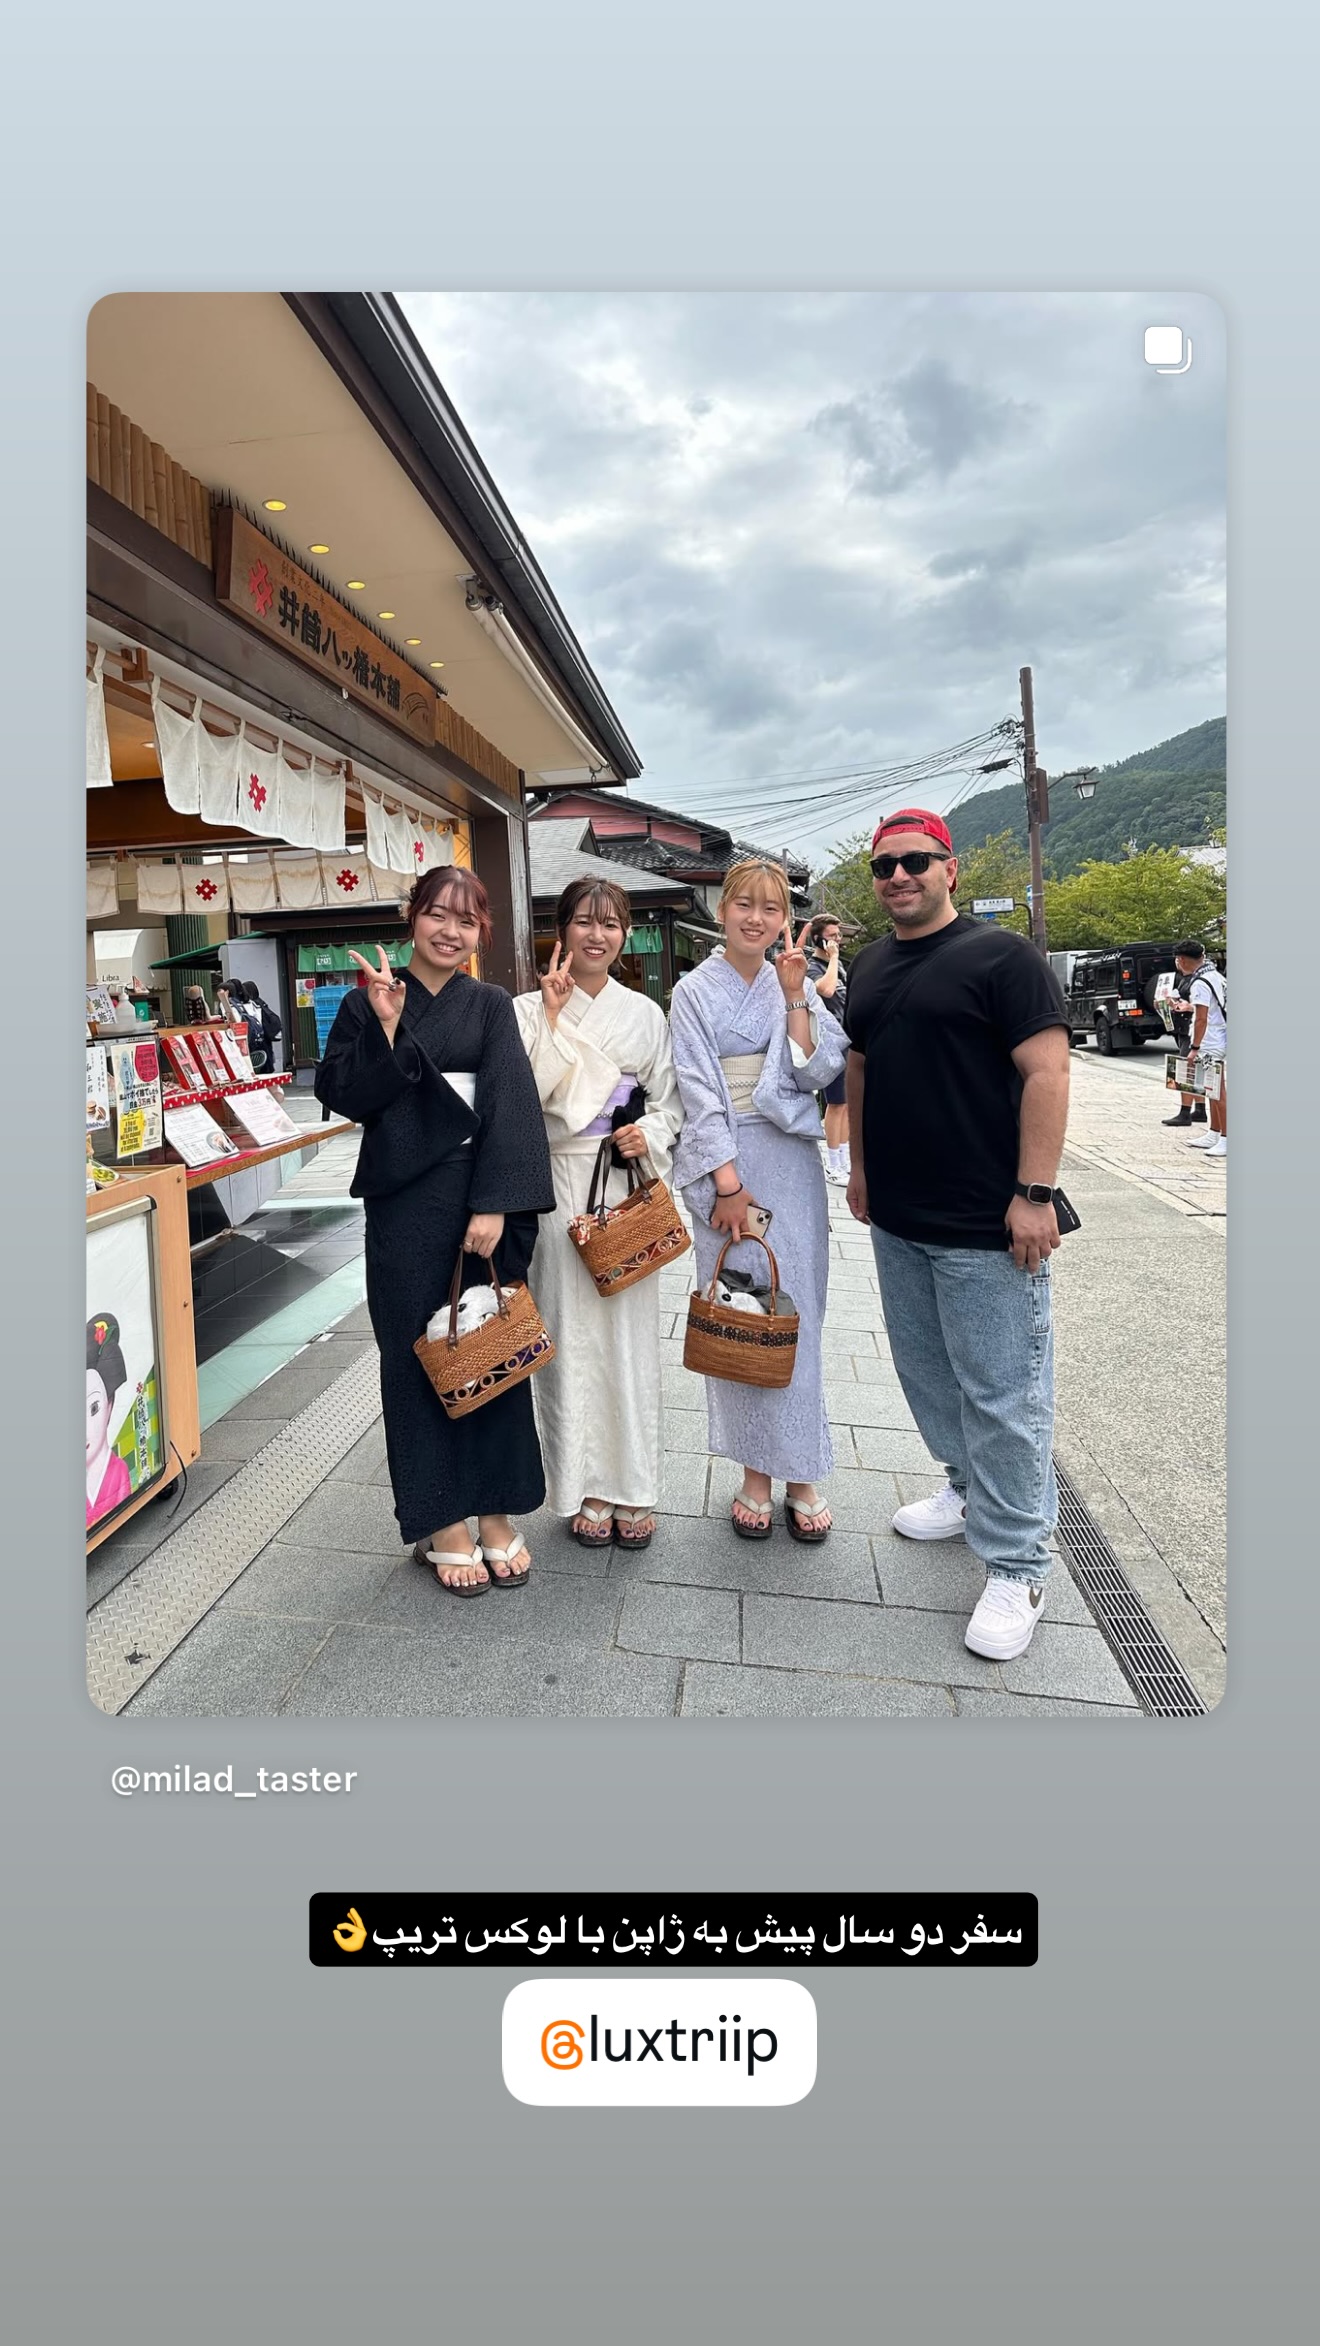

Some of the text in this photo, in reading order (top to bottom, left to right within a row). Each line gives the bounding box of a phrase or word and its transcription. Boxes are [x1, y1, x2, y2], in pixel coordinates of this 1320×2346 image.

[278, 585, 401, 712] 井筒八ッ橋本舗
[102, 974, 120, 982] Libra
